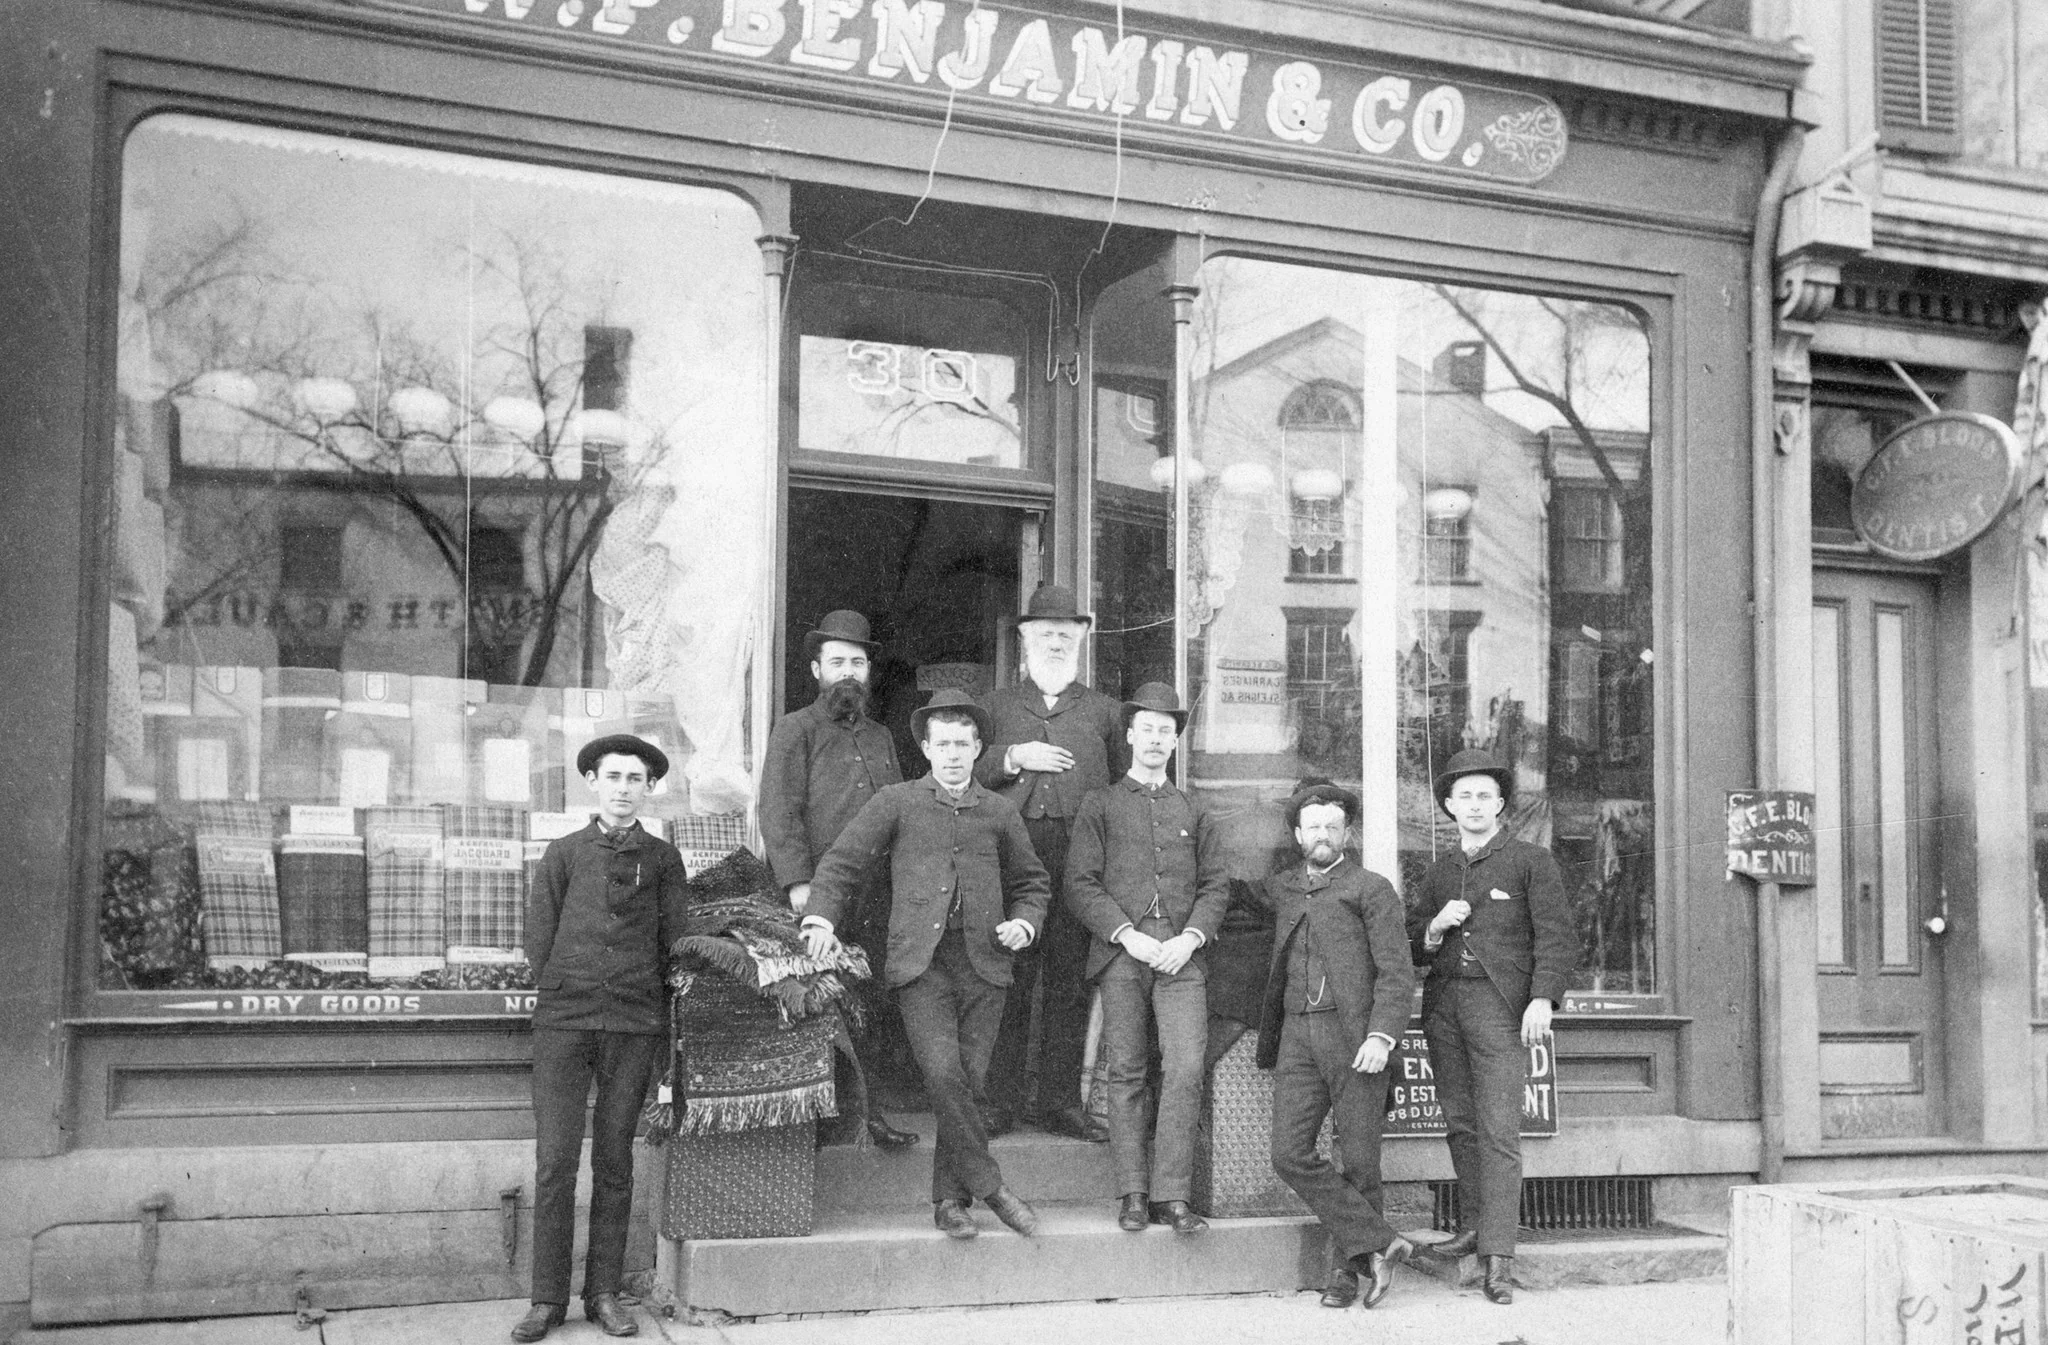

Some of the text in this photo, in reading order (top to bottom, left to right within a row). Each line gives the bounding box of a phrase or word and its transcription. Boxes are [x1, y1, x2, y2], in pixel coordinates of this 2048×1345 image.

[711, 0, 1249, 130] BENJAMIN
[1266, 62, 1330, 145] &
[1352, 77, 1484, 168] CO.
[848, 339, 978, 402] 30
[454, 847, 511, 859] JACQUARD
[241, 995, 538, 1014] DRY GOODS NO
[1412, 1039, 1429, 1050] RE
[1403, 1057, 1435, 1080] EN
[1410, 1085, 1438, 1103] EST
[1410, 1105, 1443, 1119] DUA
[1410, 1121, 1447, 1129] ESTABLI
